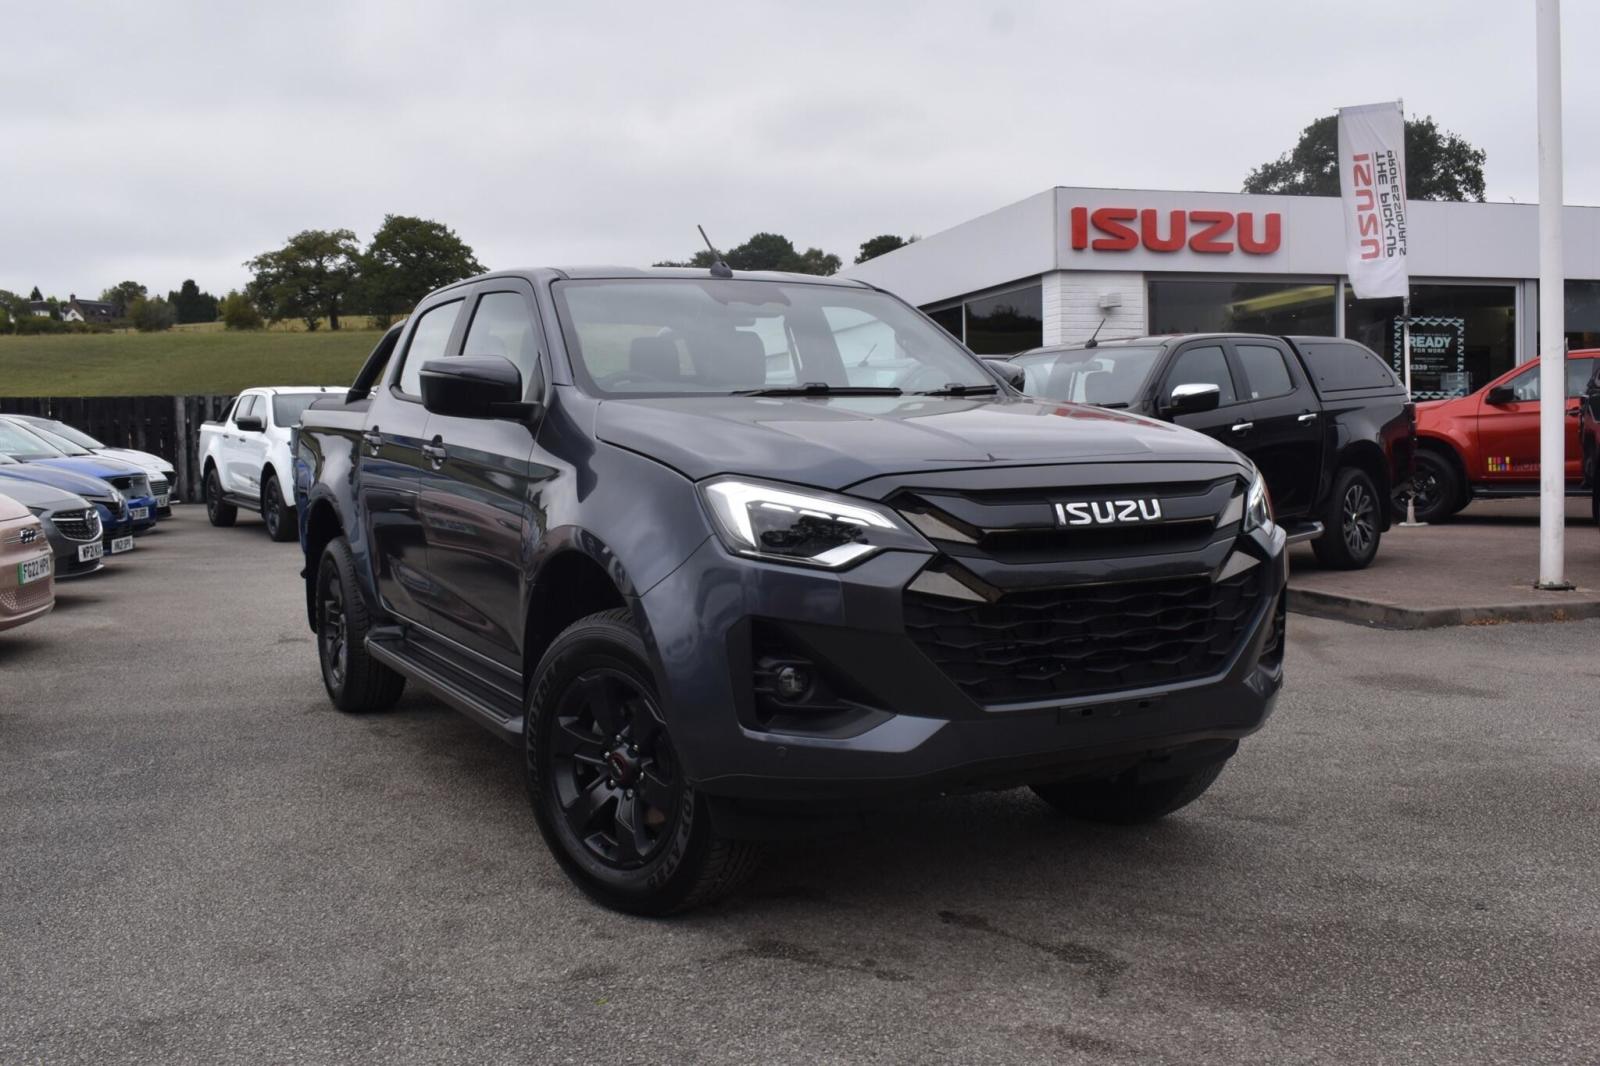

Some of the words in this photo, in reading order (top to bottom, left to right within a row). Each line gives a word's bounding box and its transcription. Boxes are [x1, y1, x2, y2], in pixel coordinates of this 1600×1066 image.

[1071, 206, 1281, 255] ISUZU
[1409, 336, 1452, 348] READY
[1055, 498, 1162, 525] ISUZU
